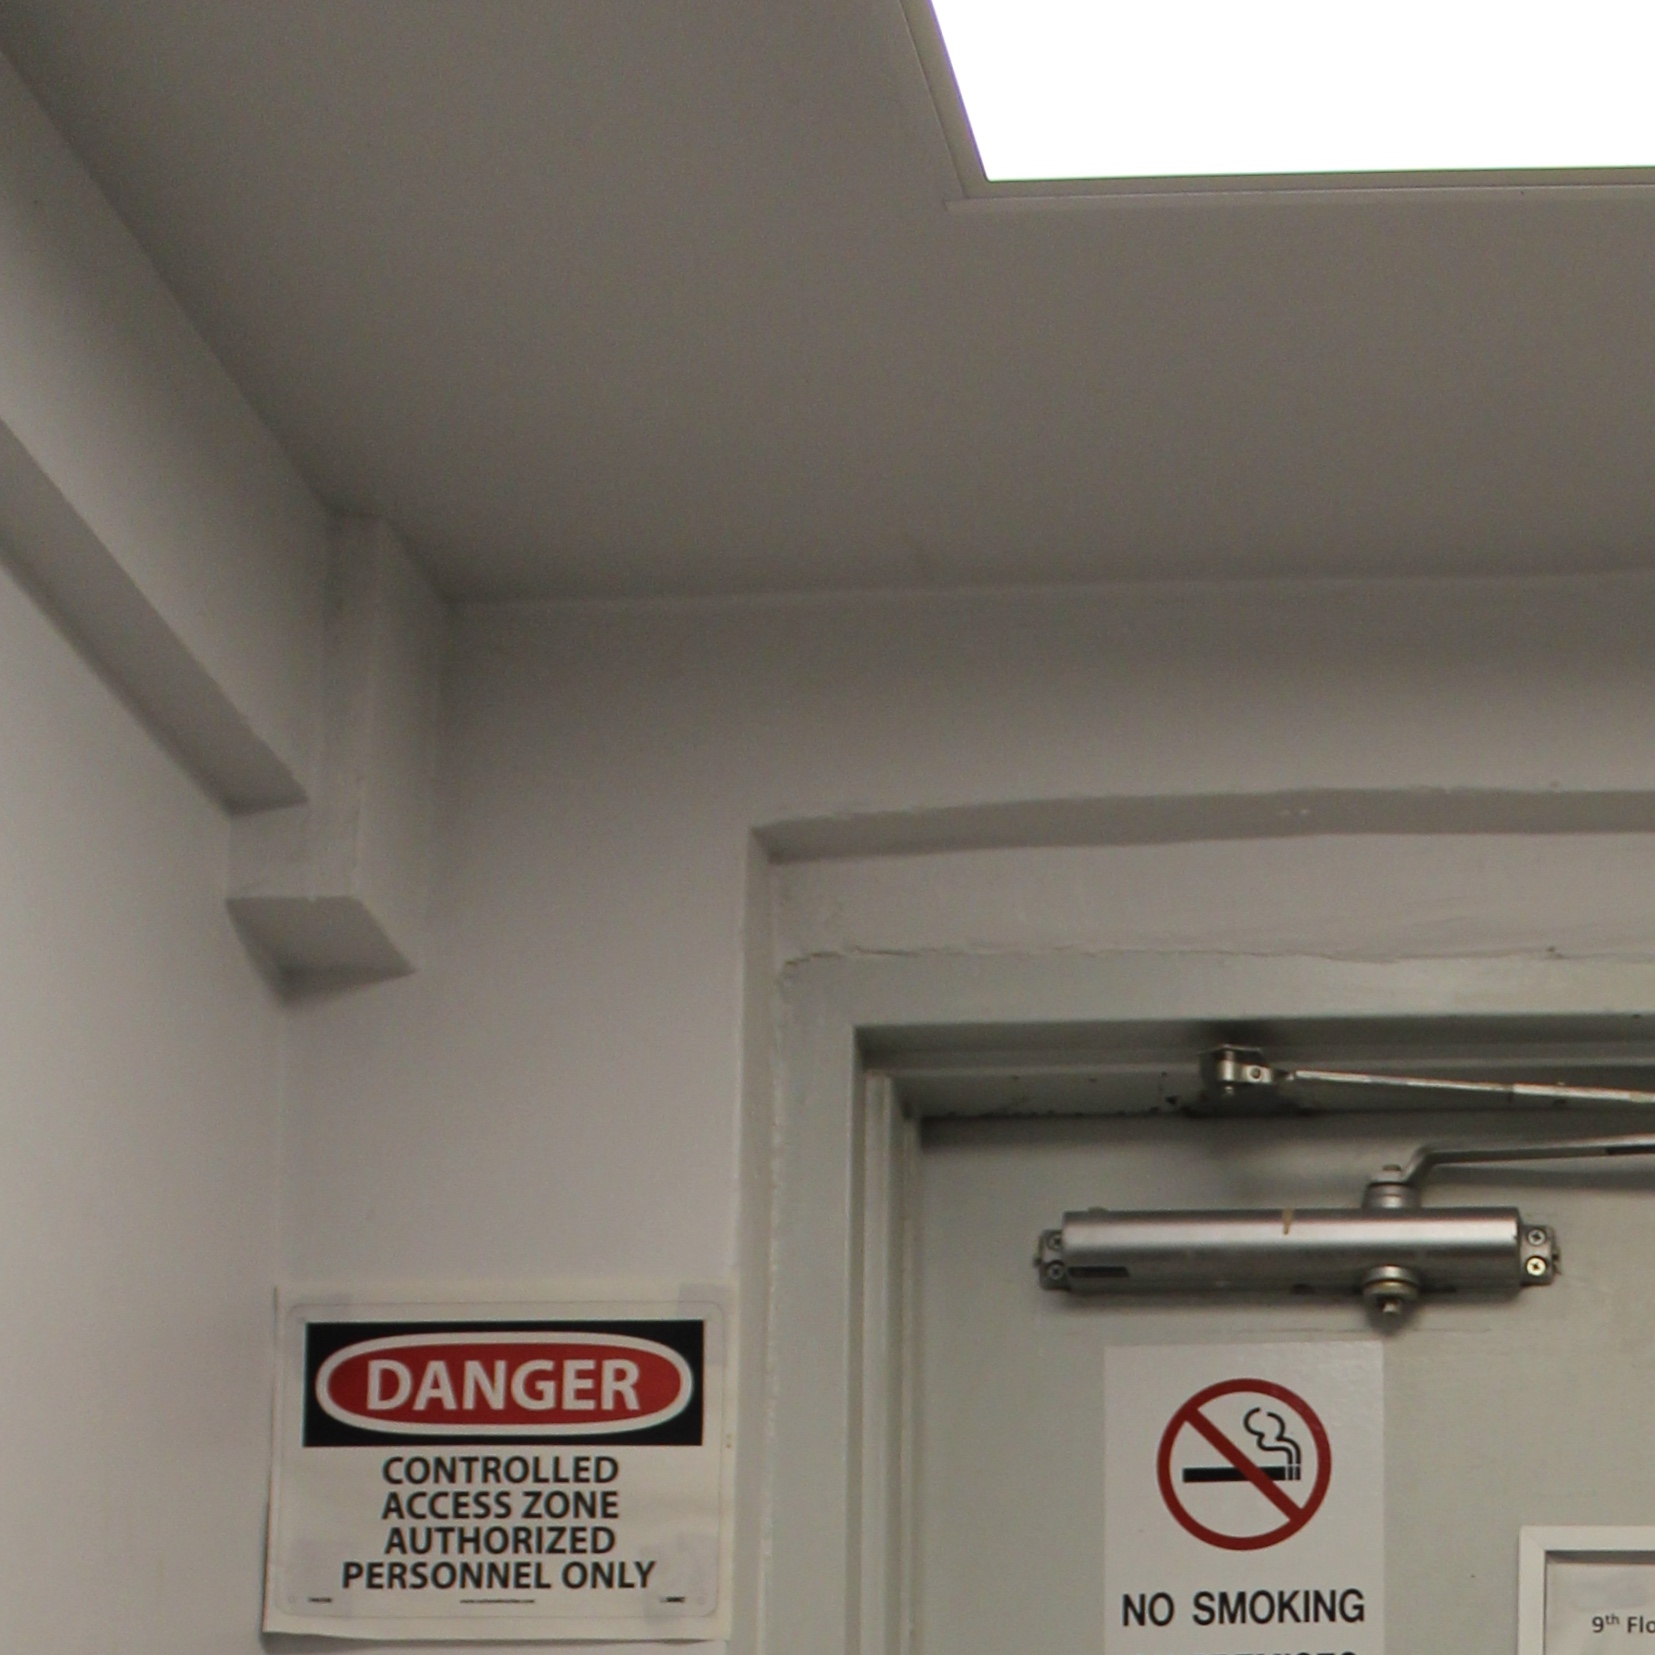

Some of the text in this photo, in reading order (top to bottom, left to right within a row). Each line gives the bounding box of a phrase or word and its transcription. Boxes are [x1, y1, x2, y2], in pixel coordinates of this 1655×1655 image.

[367, 1358, 641, 1411] DANGER
[382, 1455, 619, 1486] CONTROLLED
[381, 1490, 619, 1521] ACCESS ZONE
[384, 1525, 616, 1556] AUTHORIZED
[342, 1560, 657, 1590] PERSONNEL ONLY
[1122, 1588, 1365, 1627] NO SMOKING
[1591, 1613, 1620, 1634] 9th
